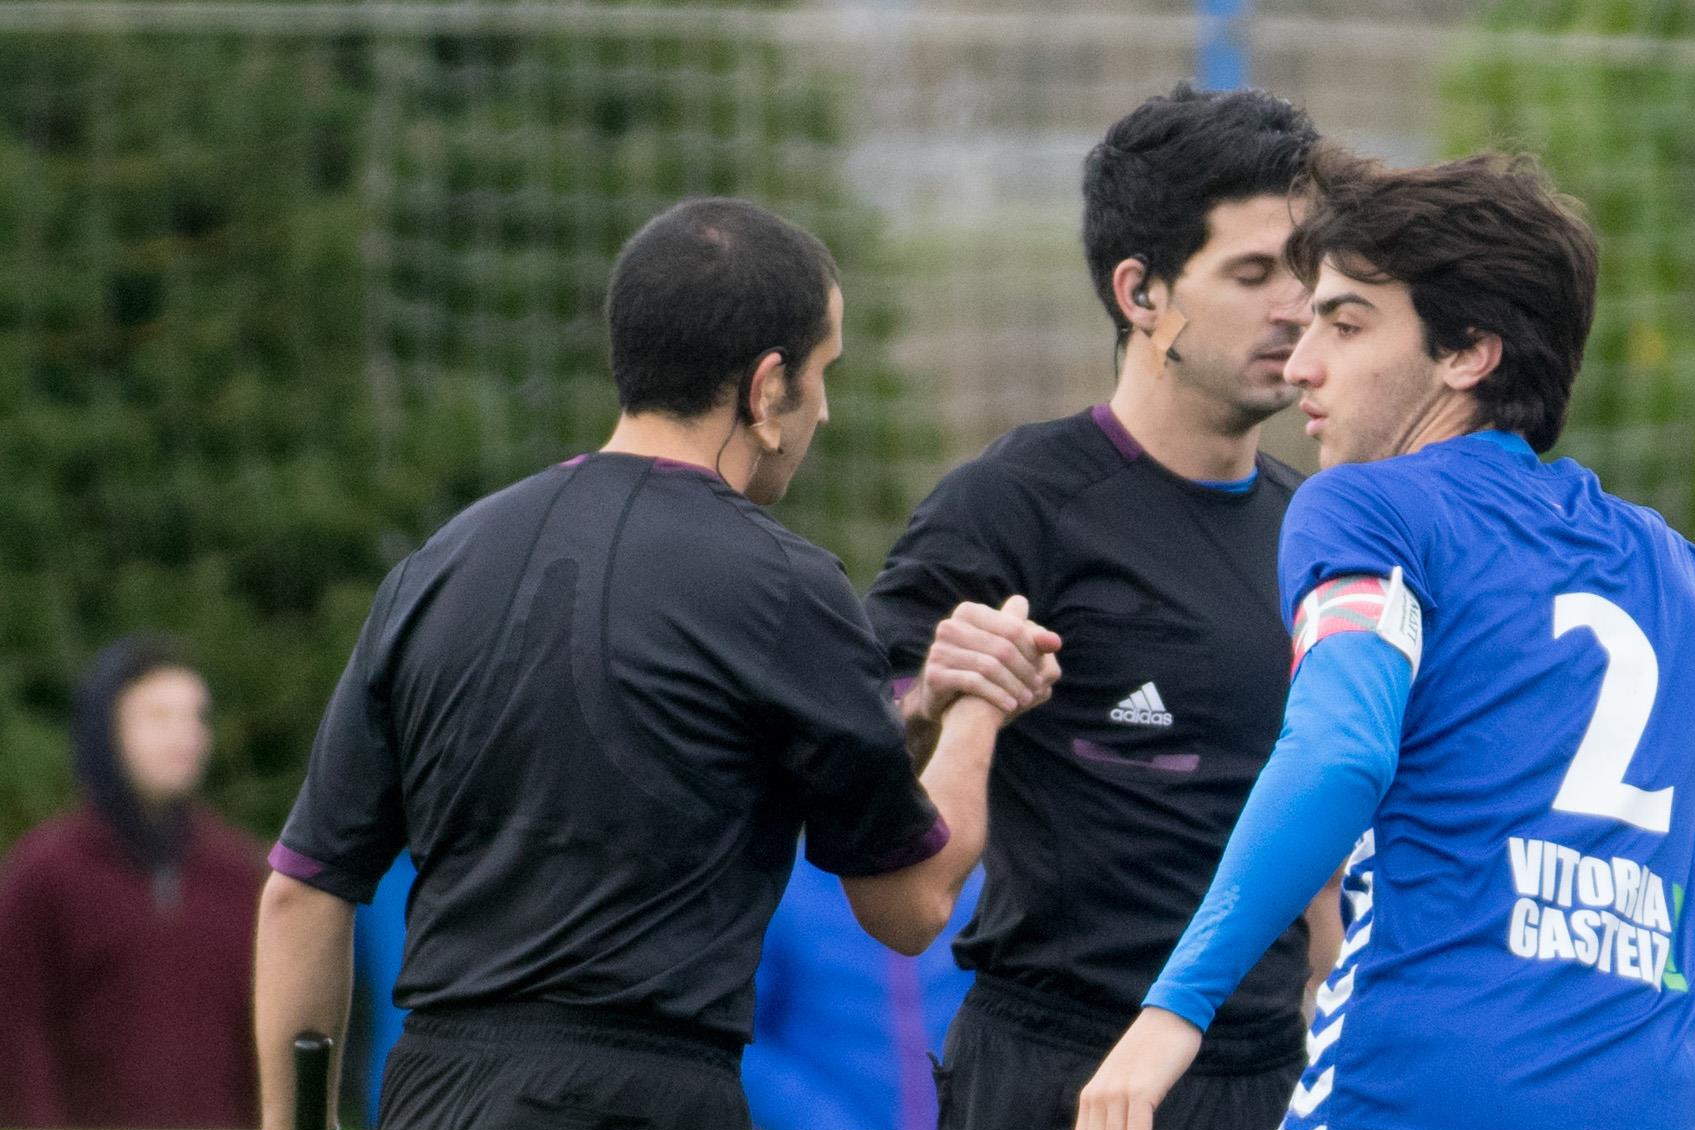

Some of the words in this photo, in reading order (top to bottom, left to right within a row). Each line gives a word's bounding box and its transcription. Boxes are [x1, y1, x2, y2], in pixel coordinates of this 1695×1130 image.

[1110, 708, 1173, 726] adidas
[1552, 592, 1675, 833] 2
[1509, 836, 1672, 933] VITORIA
